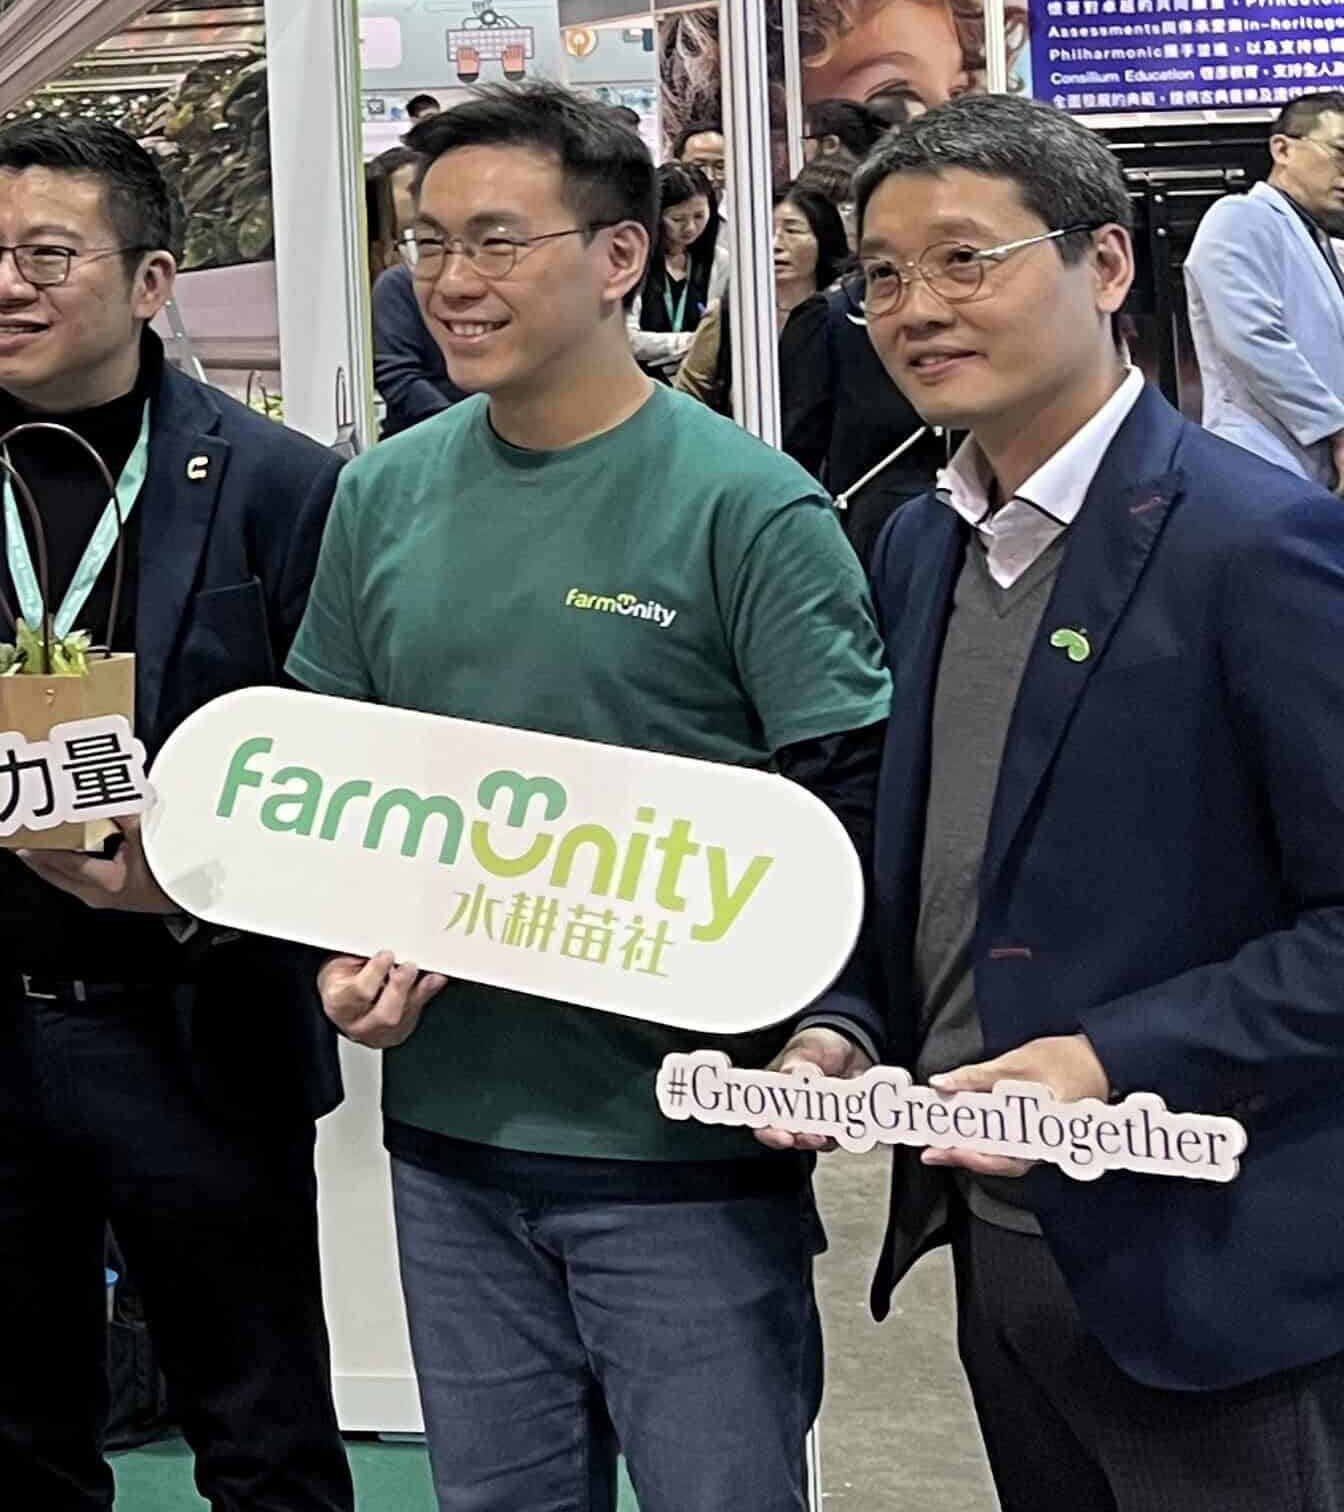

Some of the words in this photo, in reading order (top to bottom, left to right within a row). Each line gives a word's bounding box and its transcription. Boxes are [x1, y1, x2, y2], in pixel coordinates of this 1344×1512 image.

[1048, 22, 1160, 39] Assessments
[1049, 45, 1161, 63] Philharmonic
[1124, 66, 1195, 83] Education
[442, 882, 678, 978] 水耕苗社
[667, 1062, 1228, 1168] #GrowingGreenTogether
